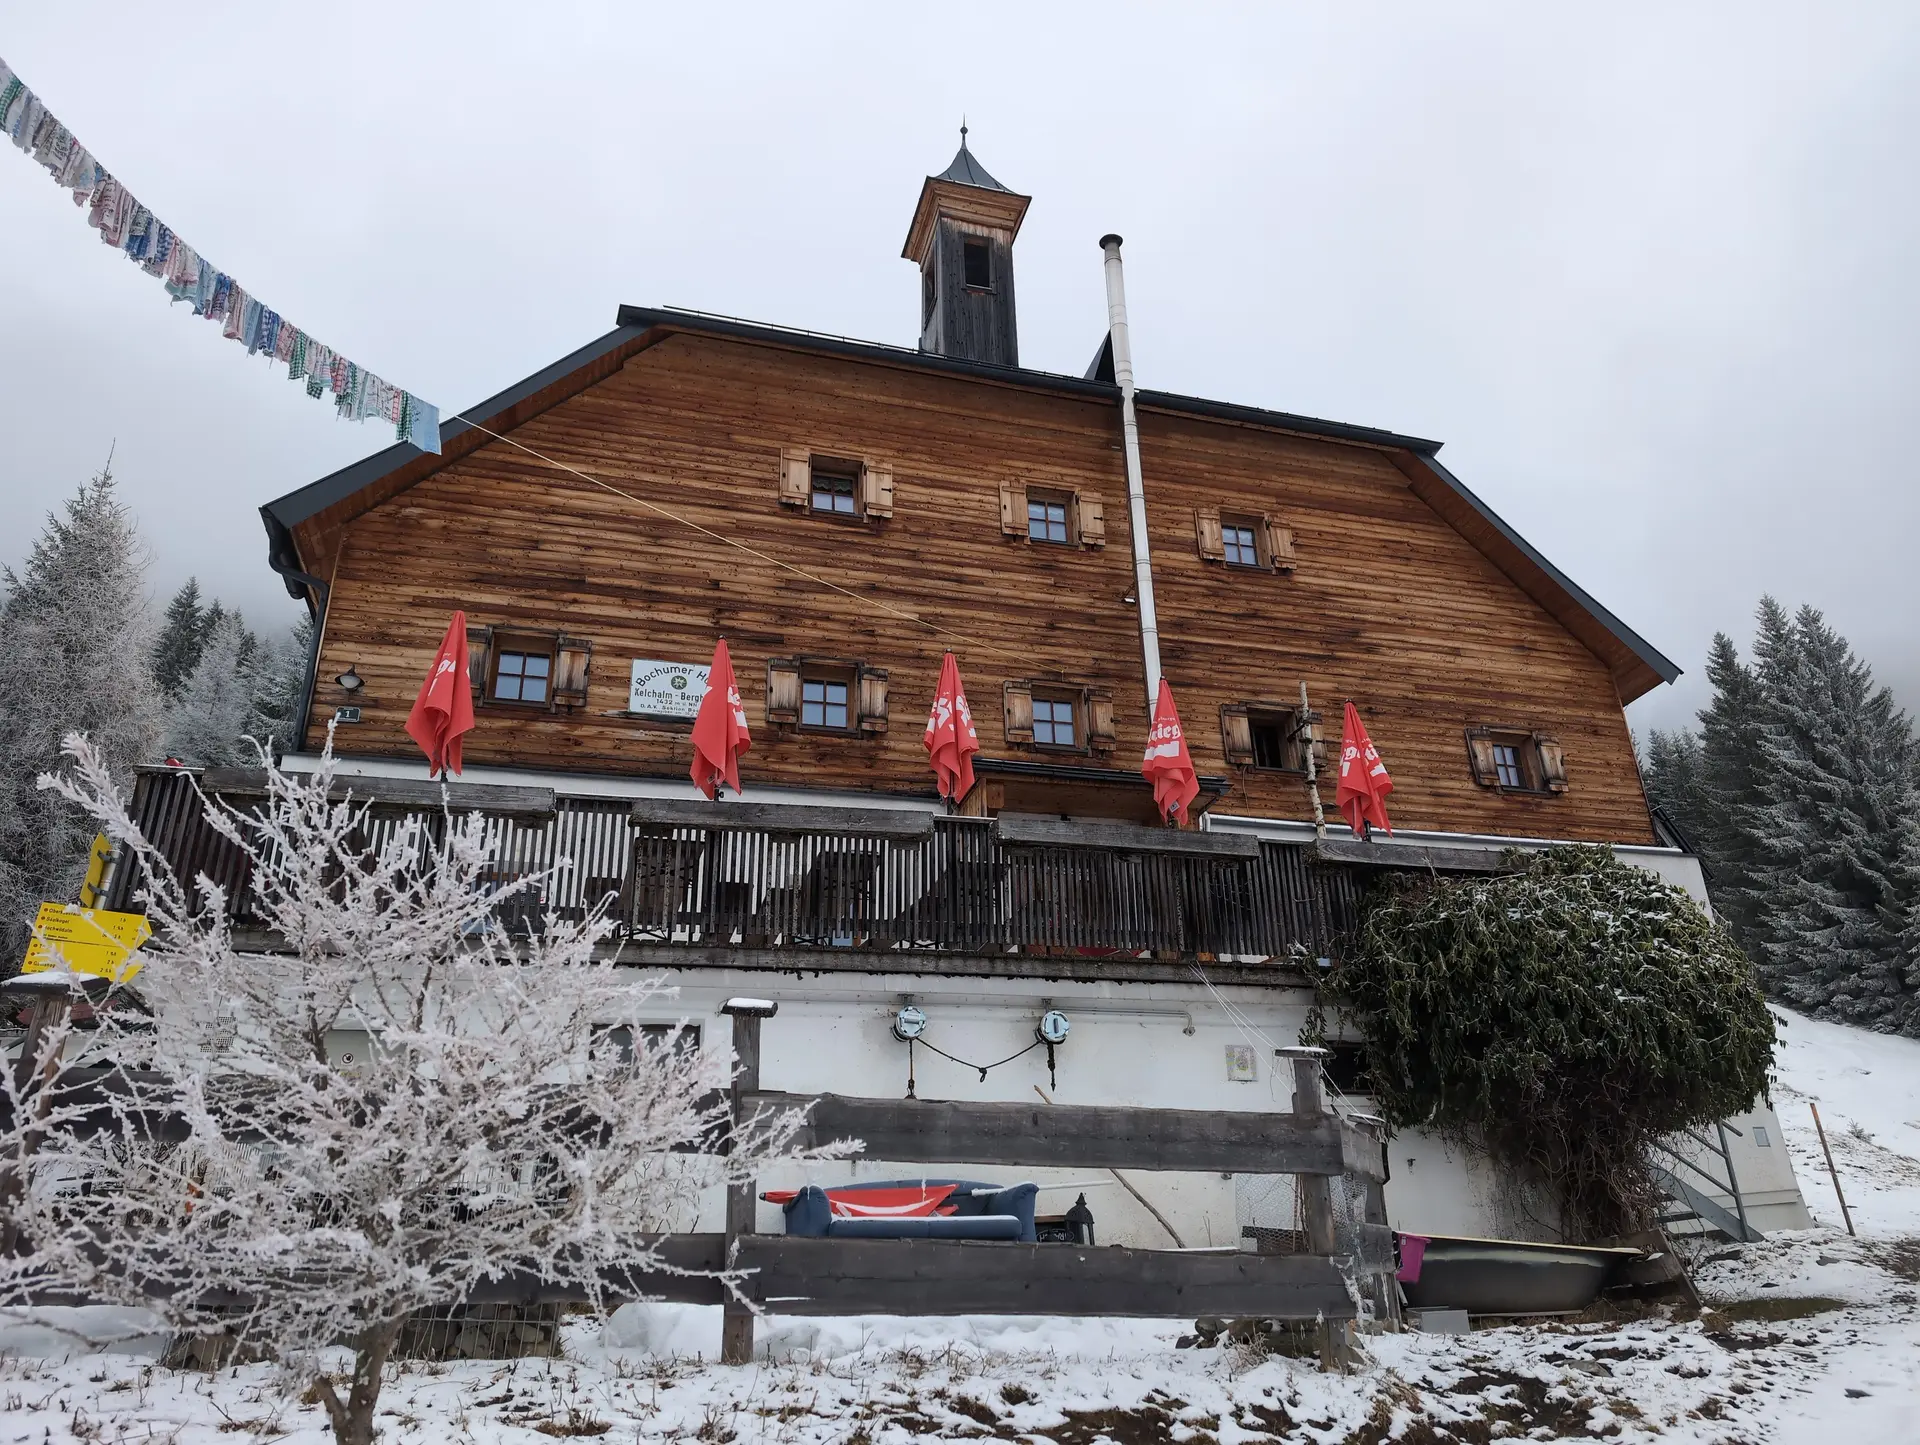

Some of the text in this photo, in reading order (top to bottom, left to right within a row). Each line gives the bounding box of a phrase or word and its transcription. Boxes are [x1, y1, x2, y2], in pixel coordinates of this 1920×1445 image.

[635, 666, 694, 687] Bochumer
[634, 688, 673, 699] Kelchalm
[345, 710, 350, 718] 1
